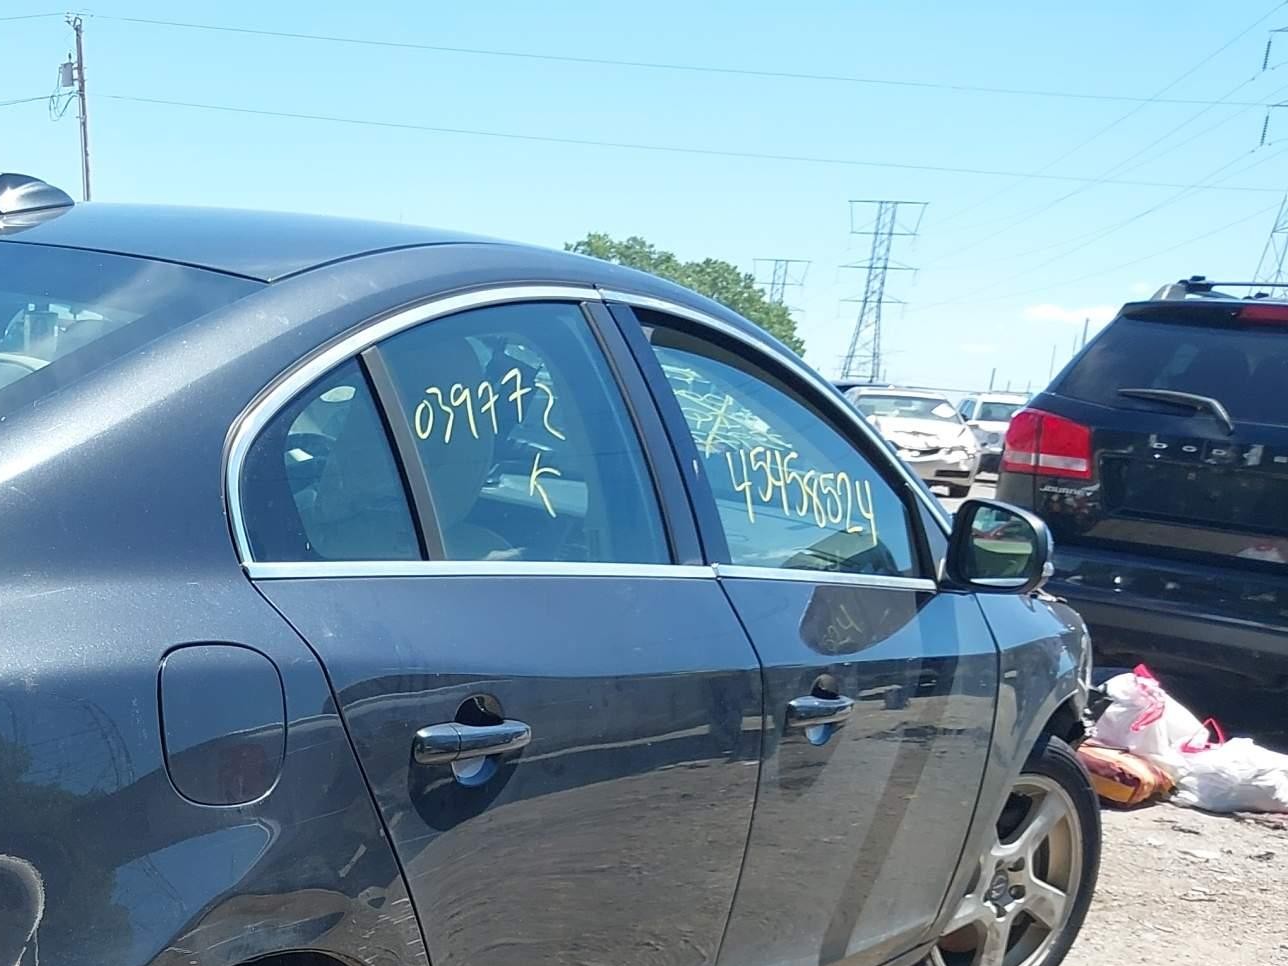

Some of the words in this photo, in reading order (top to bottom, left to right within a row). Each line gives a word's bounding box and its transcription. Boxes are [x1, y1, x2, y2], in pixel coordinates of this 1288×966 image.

[414, 367, 566, 444] 039772
[529, 452, 562, 519] K
[725, 446, 879, 547] 45458524
